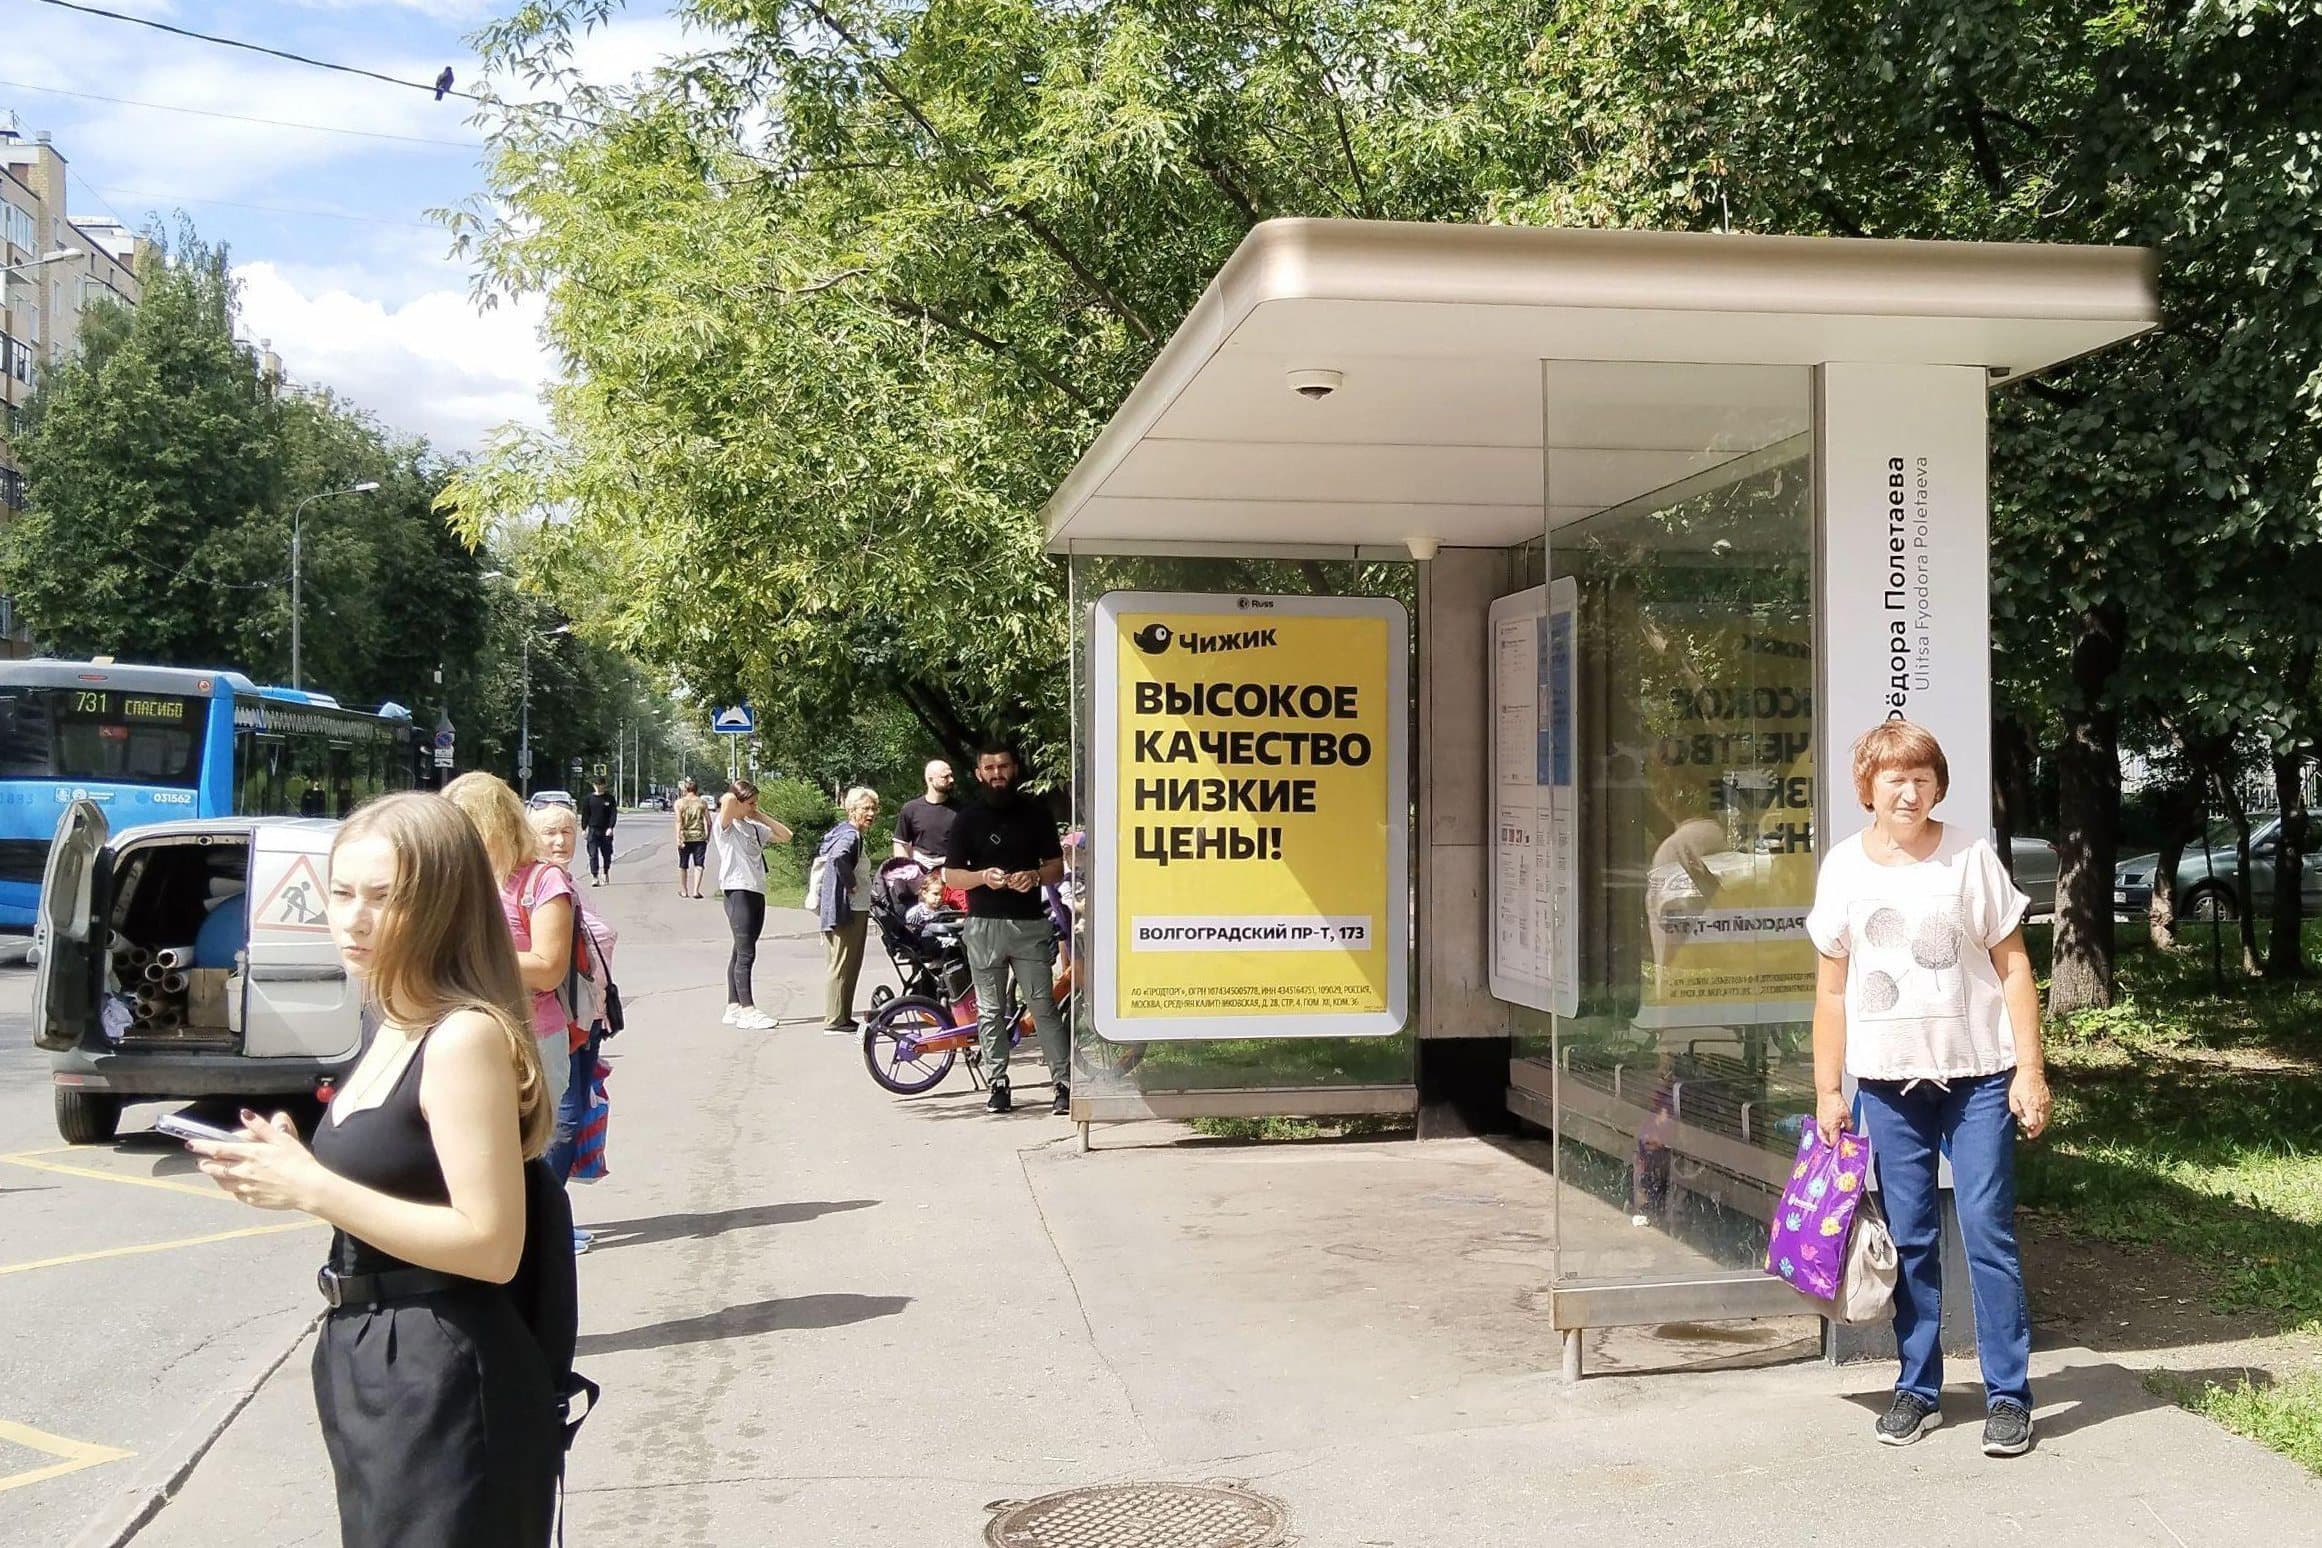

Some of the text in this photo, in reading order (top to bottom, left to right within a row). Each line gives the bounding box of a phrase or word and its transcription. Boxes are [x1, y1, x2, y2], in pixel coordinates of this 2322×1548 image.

[1884, 457, 1906, 610] Полетаева
[1913, 457, 1933, 691] Ulitsa Fyodora Poletaeva
[1251, 600, 1274, 608] Russ
[76, 691, 107, 713] 731
[124, 700, 183, 718] СПАСИБО
[1135, 681, 1358, 719] ВЫСОКОЕ
[1135, 730, 1372, 766] КАЧЕСТВО
[153, 793, 192, 804] 031562
[1135, 778, 1317, 813] НИЗКИЕ
[1135, 826, 1282, 867] ЦЕНЫ!
[1139, 923, 1365, 942] ВОЛГОГРАДСКИЙ ПР-Т, 173
